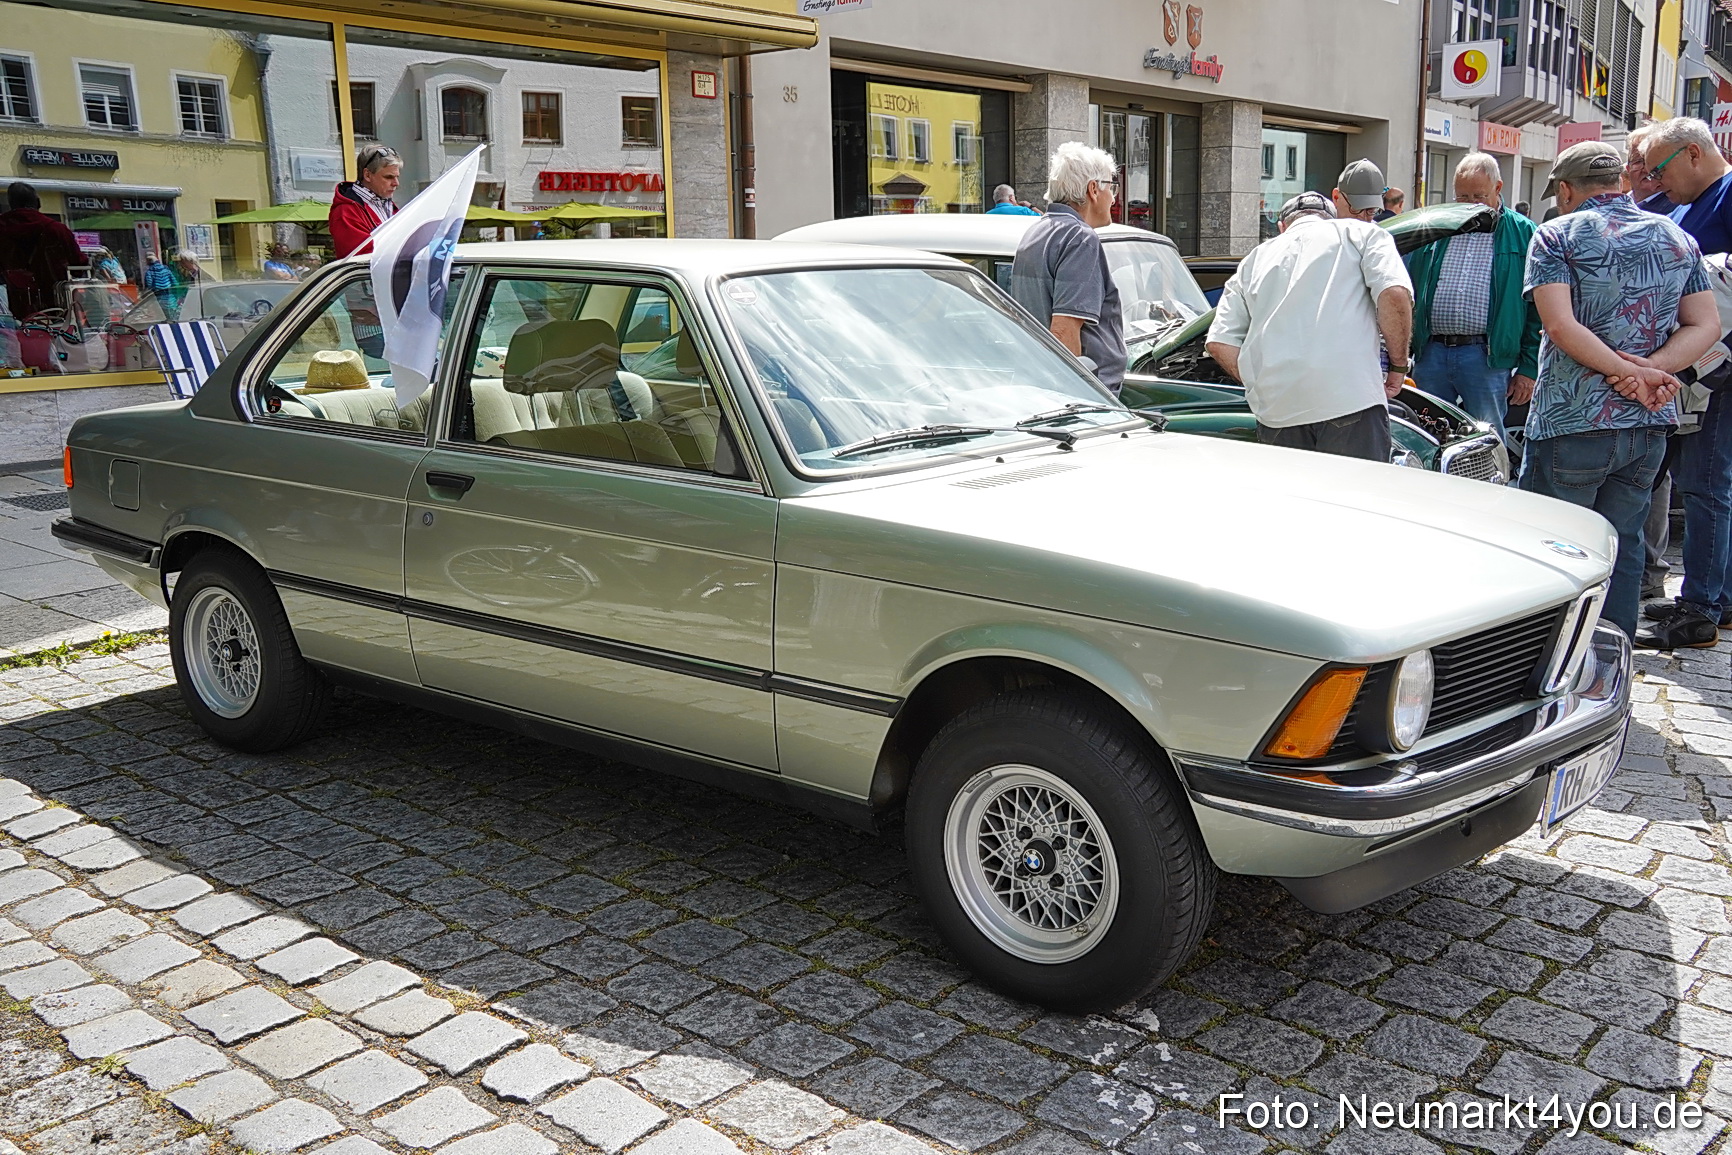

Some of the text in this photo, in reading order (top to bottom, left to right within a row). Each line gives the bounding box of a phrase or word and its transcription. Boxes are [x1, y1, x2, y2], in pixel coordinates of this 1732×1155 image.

[1190, 51, 1224, 84] family
[783, 85, 798, 103] 35
[1443, 119, 1451, 138] BR
[1486, 127, 1521, 150] ON POINT
[1558, 762, 1588, 812] RH
